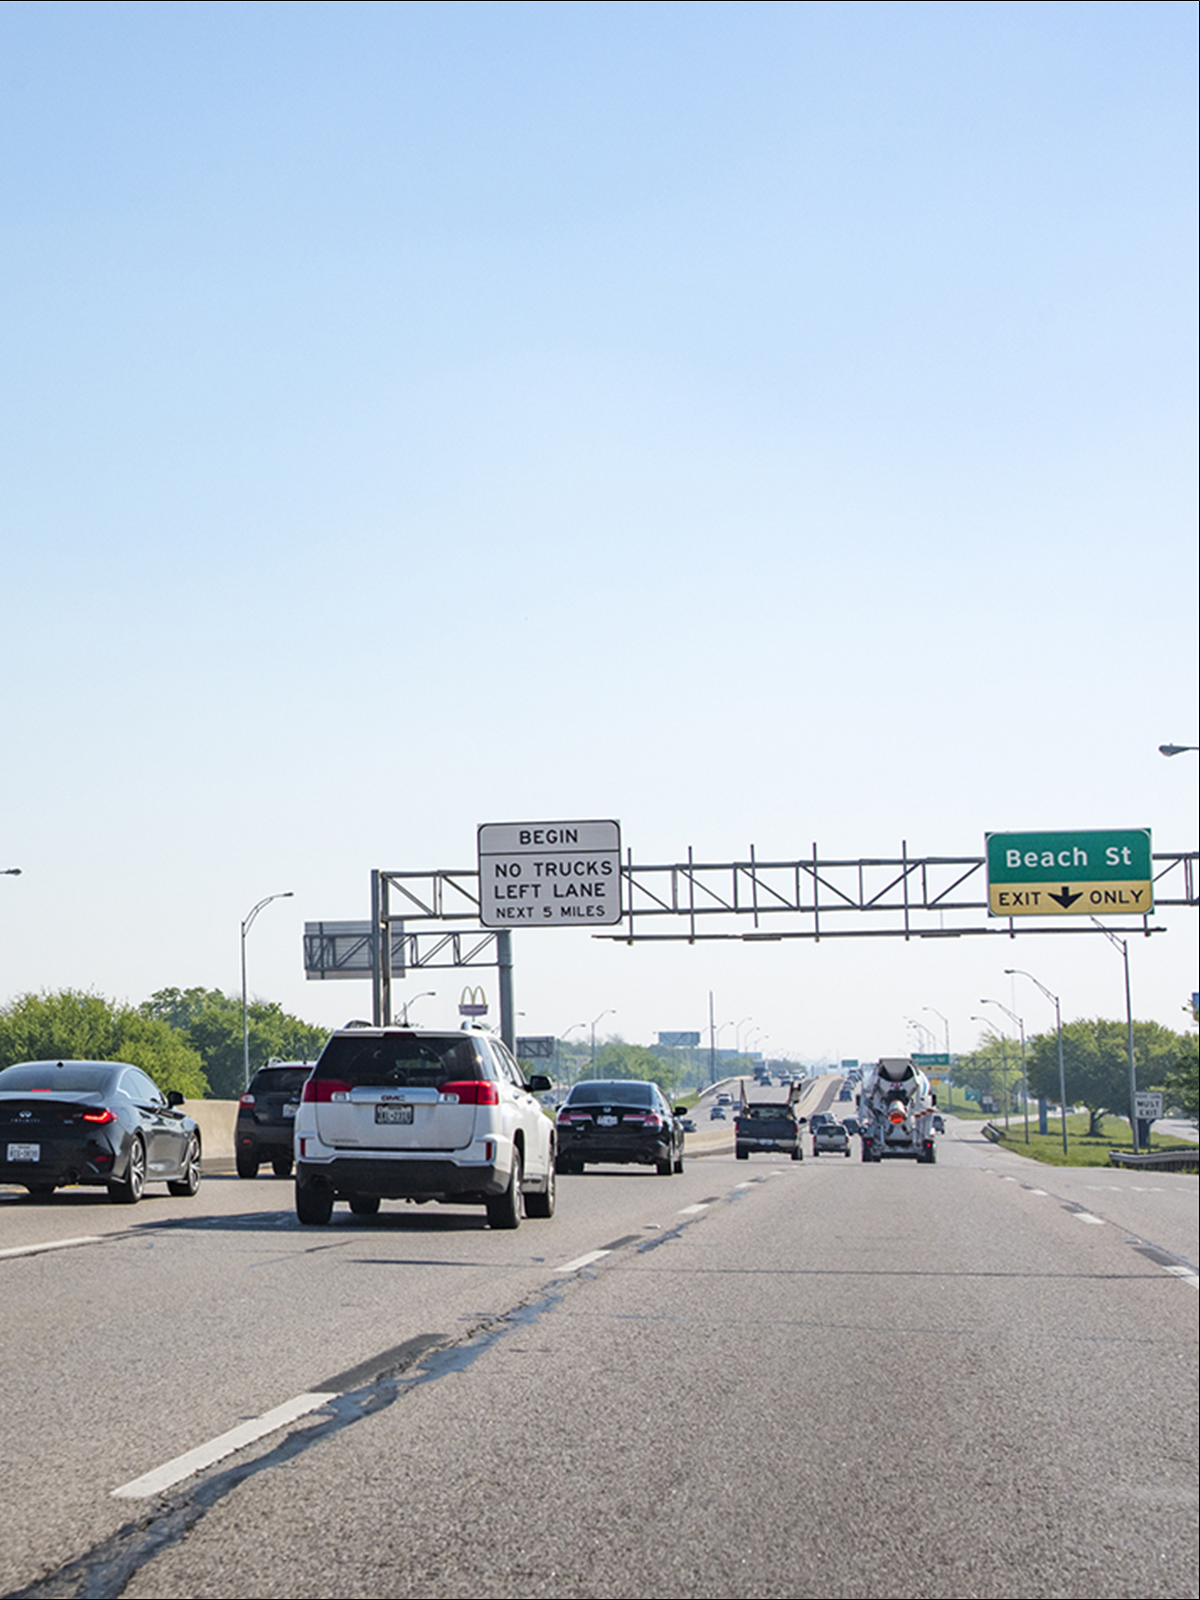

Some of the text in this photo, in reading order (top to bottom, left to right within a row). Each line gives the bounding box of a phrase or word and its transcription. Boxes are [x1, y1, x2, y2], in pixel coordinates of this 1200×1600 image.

[519, 829, 578, 845] BEGIN
[1006, 846, 1132, 868] Beach St
[495, 860, 613, 878] NO TRUCKS
[494, 883, 606, 899] LEFT LANE
[999, 889, 1144, 906] EXIT ONLY
[496, 905, 605, 918] NEXT 5 MILES
[381, 1094, 406, 1102] GMC
